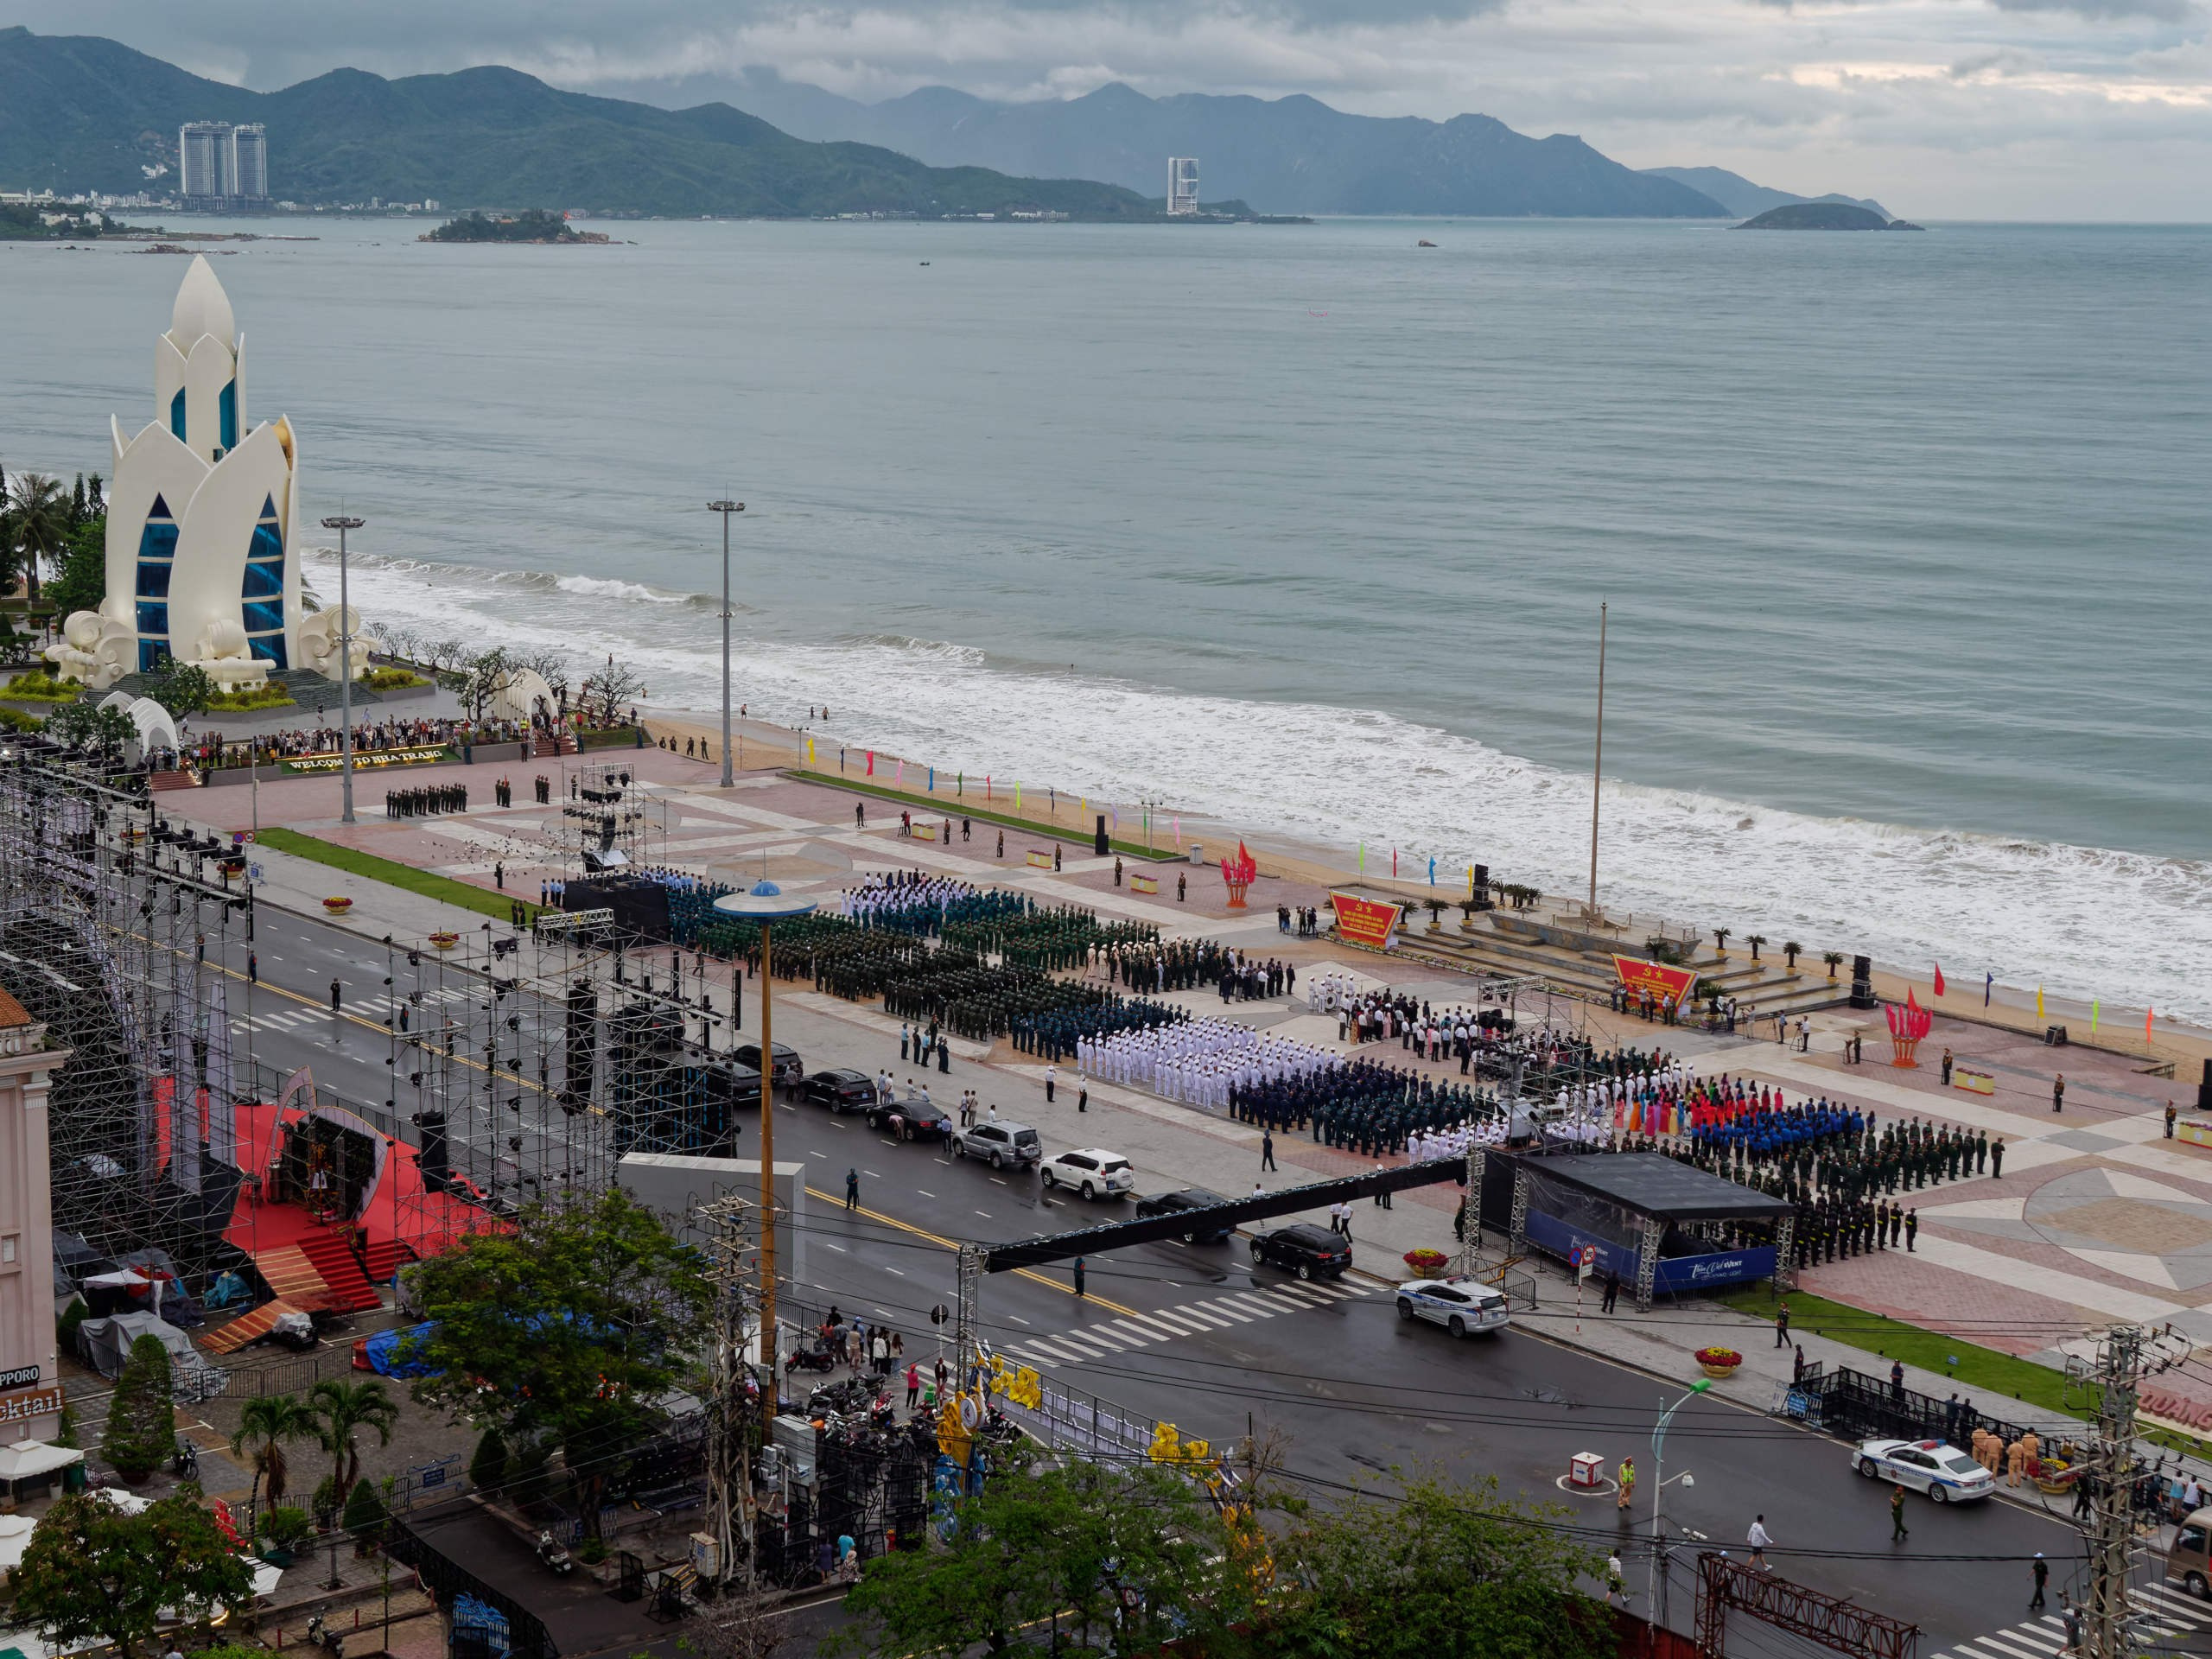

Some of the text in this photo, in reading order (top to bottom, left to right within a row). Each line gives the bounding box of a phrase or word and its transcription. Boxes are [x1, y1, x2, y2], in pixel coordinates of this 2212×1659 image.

[290, 759, 353, 769] WELCOM
[372, 754, 399, 764] NHA
[400, 751, 442, 761] TRANG
[0, 1367, 39, 1387] PPORO
